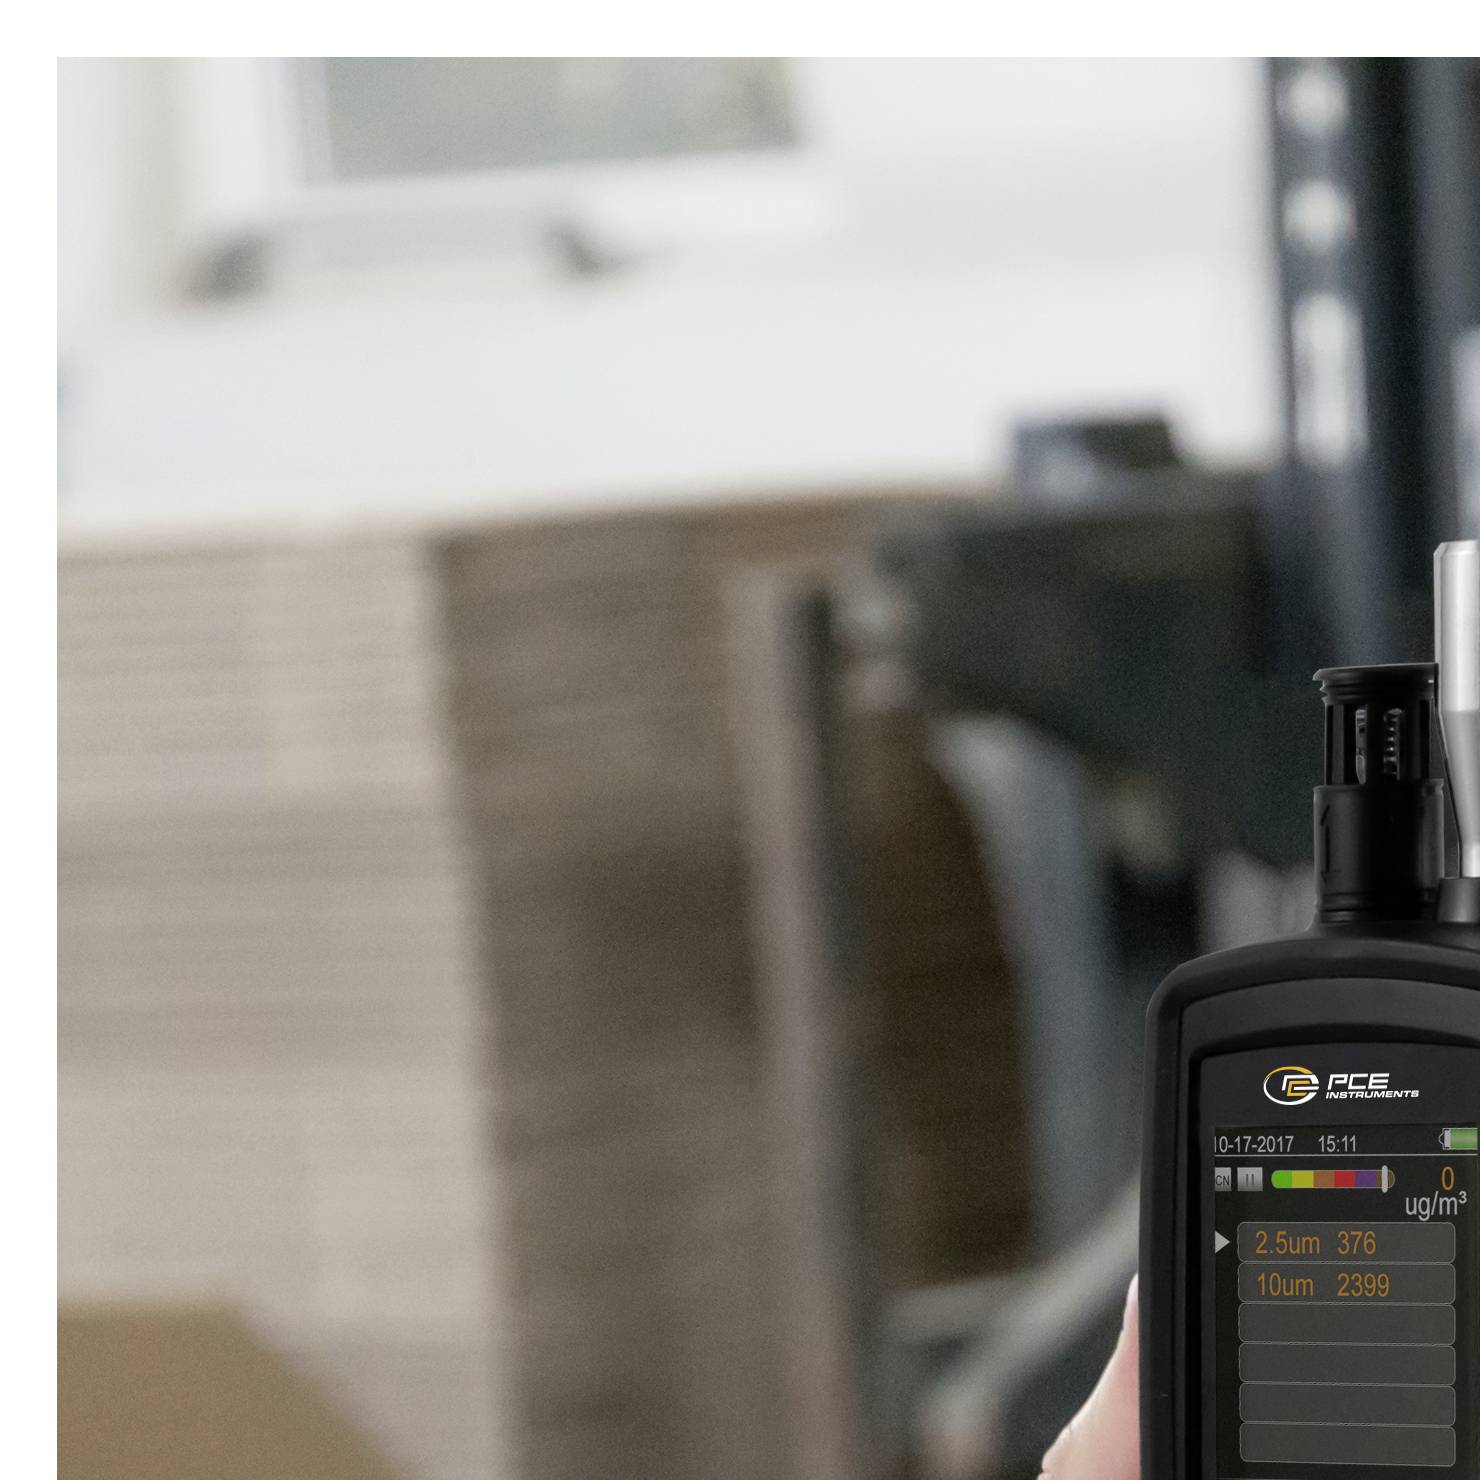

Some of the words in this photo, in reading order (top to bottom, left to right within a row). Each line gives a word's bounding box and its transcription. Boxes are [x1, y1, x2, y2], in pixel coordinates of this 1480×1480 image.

[1327, 1072, 1390, 1090] PCE
[1325, 1090, 1420, 1100] INSTRUMENTS
[1318, 1135, 1357, 1153] 15:11
[1441, 1166, 1455, 1191] 0
[1255, 1230, 1320, 1255] 2.5um
[1337, 1230, 1376, 1255] 376
[1257, 1272, 1314, 1297] 10um
[1336, 1272, 1390, 1297] 2399
